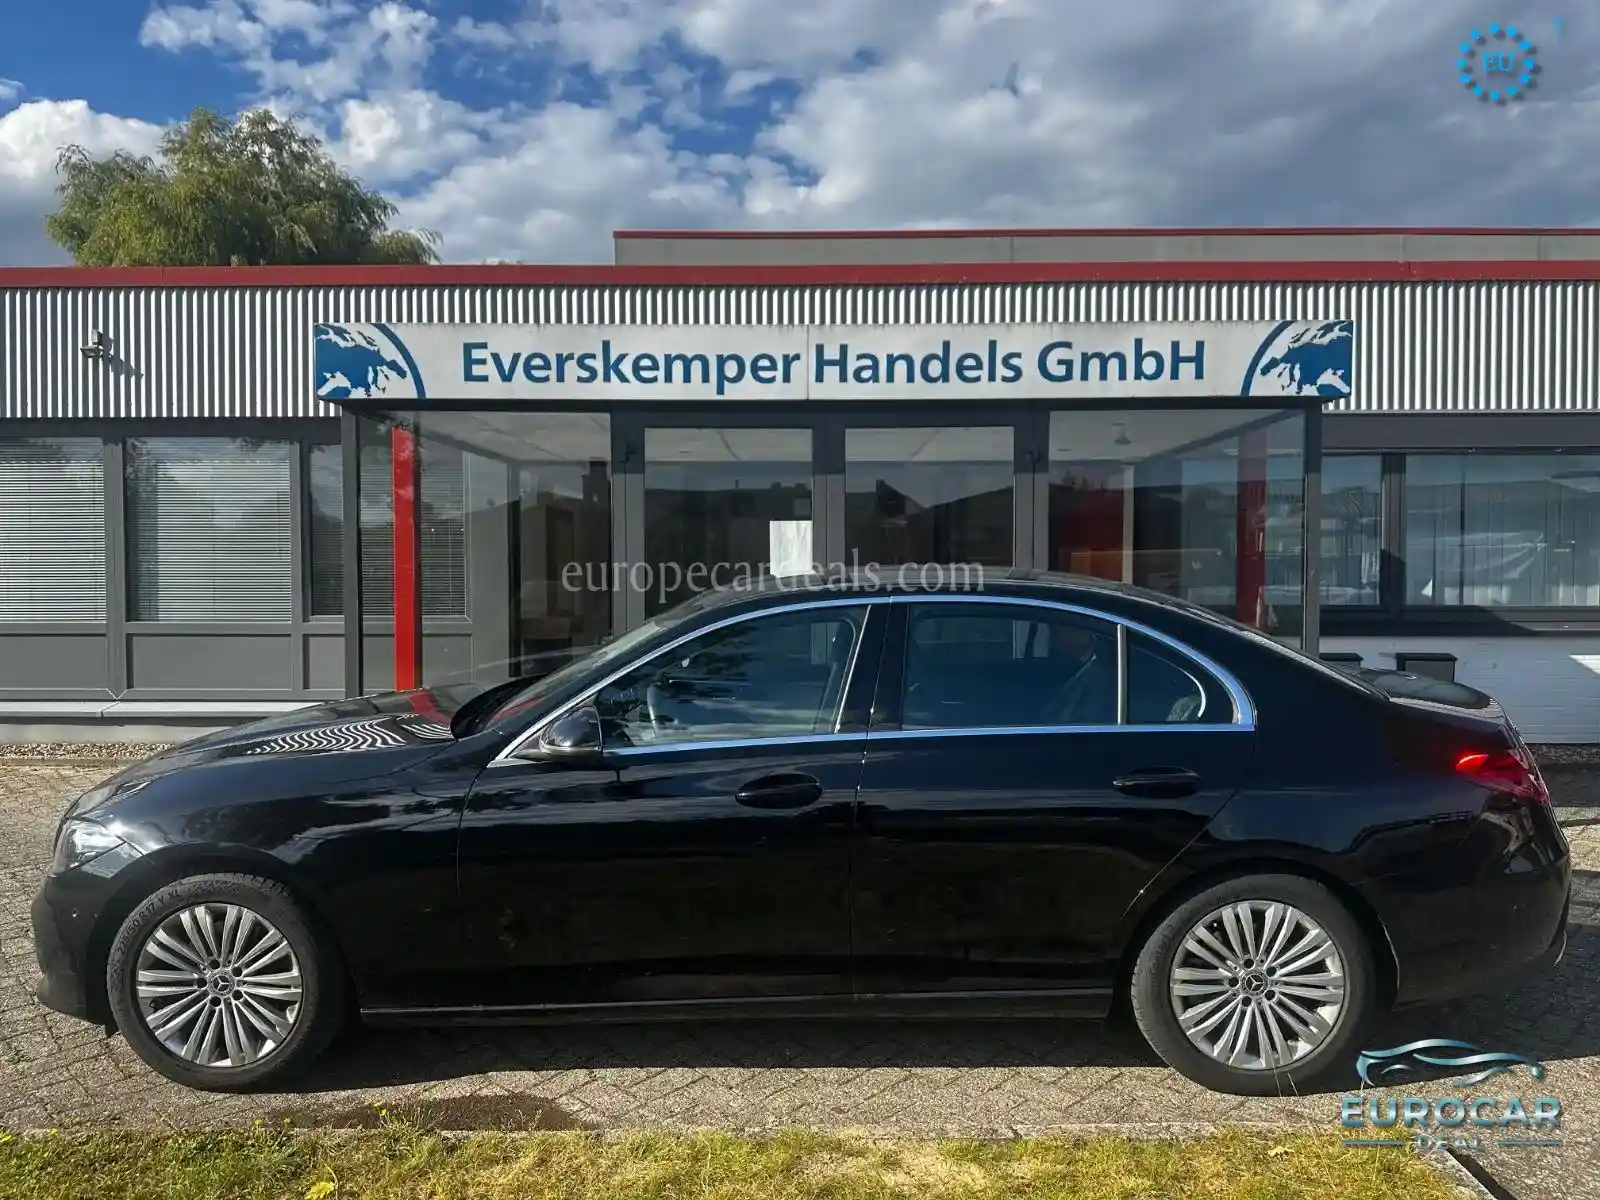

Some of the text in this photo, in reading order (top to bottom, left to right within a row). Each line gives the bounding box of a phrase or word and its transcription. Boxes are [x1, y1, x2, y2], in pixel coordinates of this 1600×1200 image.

[462, 338, 1206, 395] Everskemper Handels GmbH
[167, 889, 182, 901] XL
